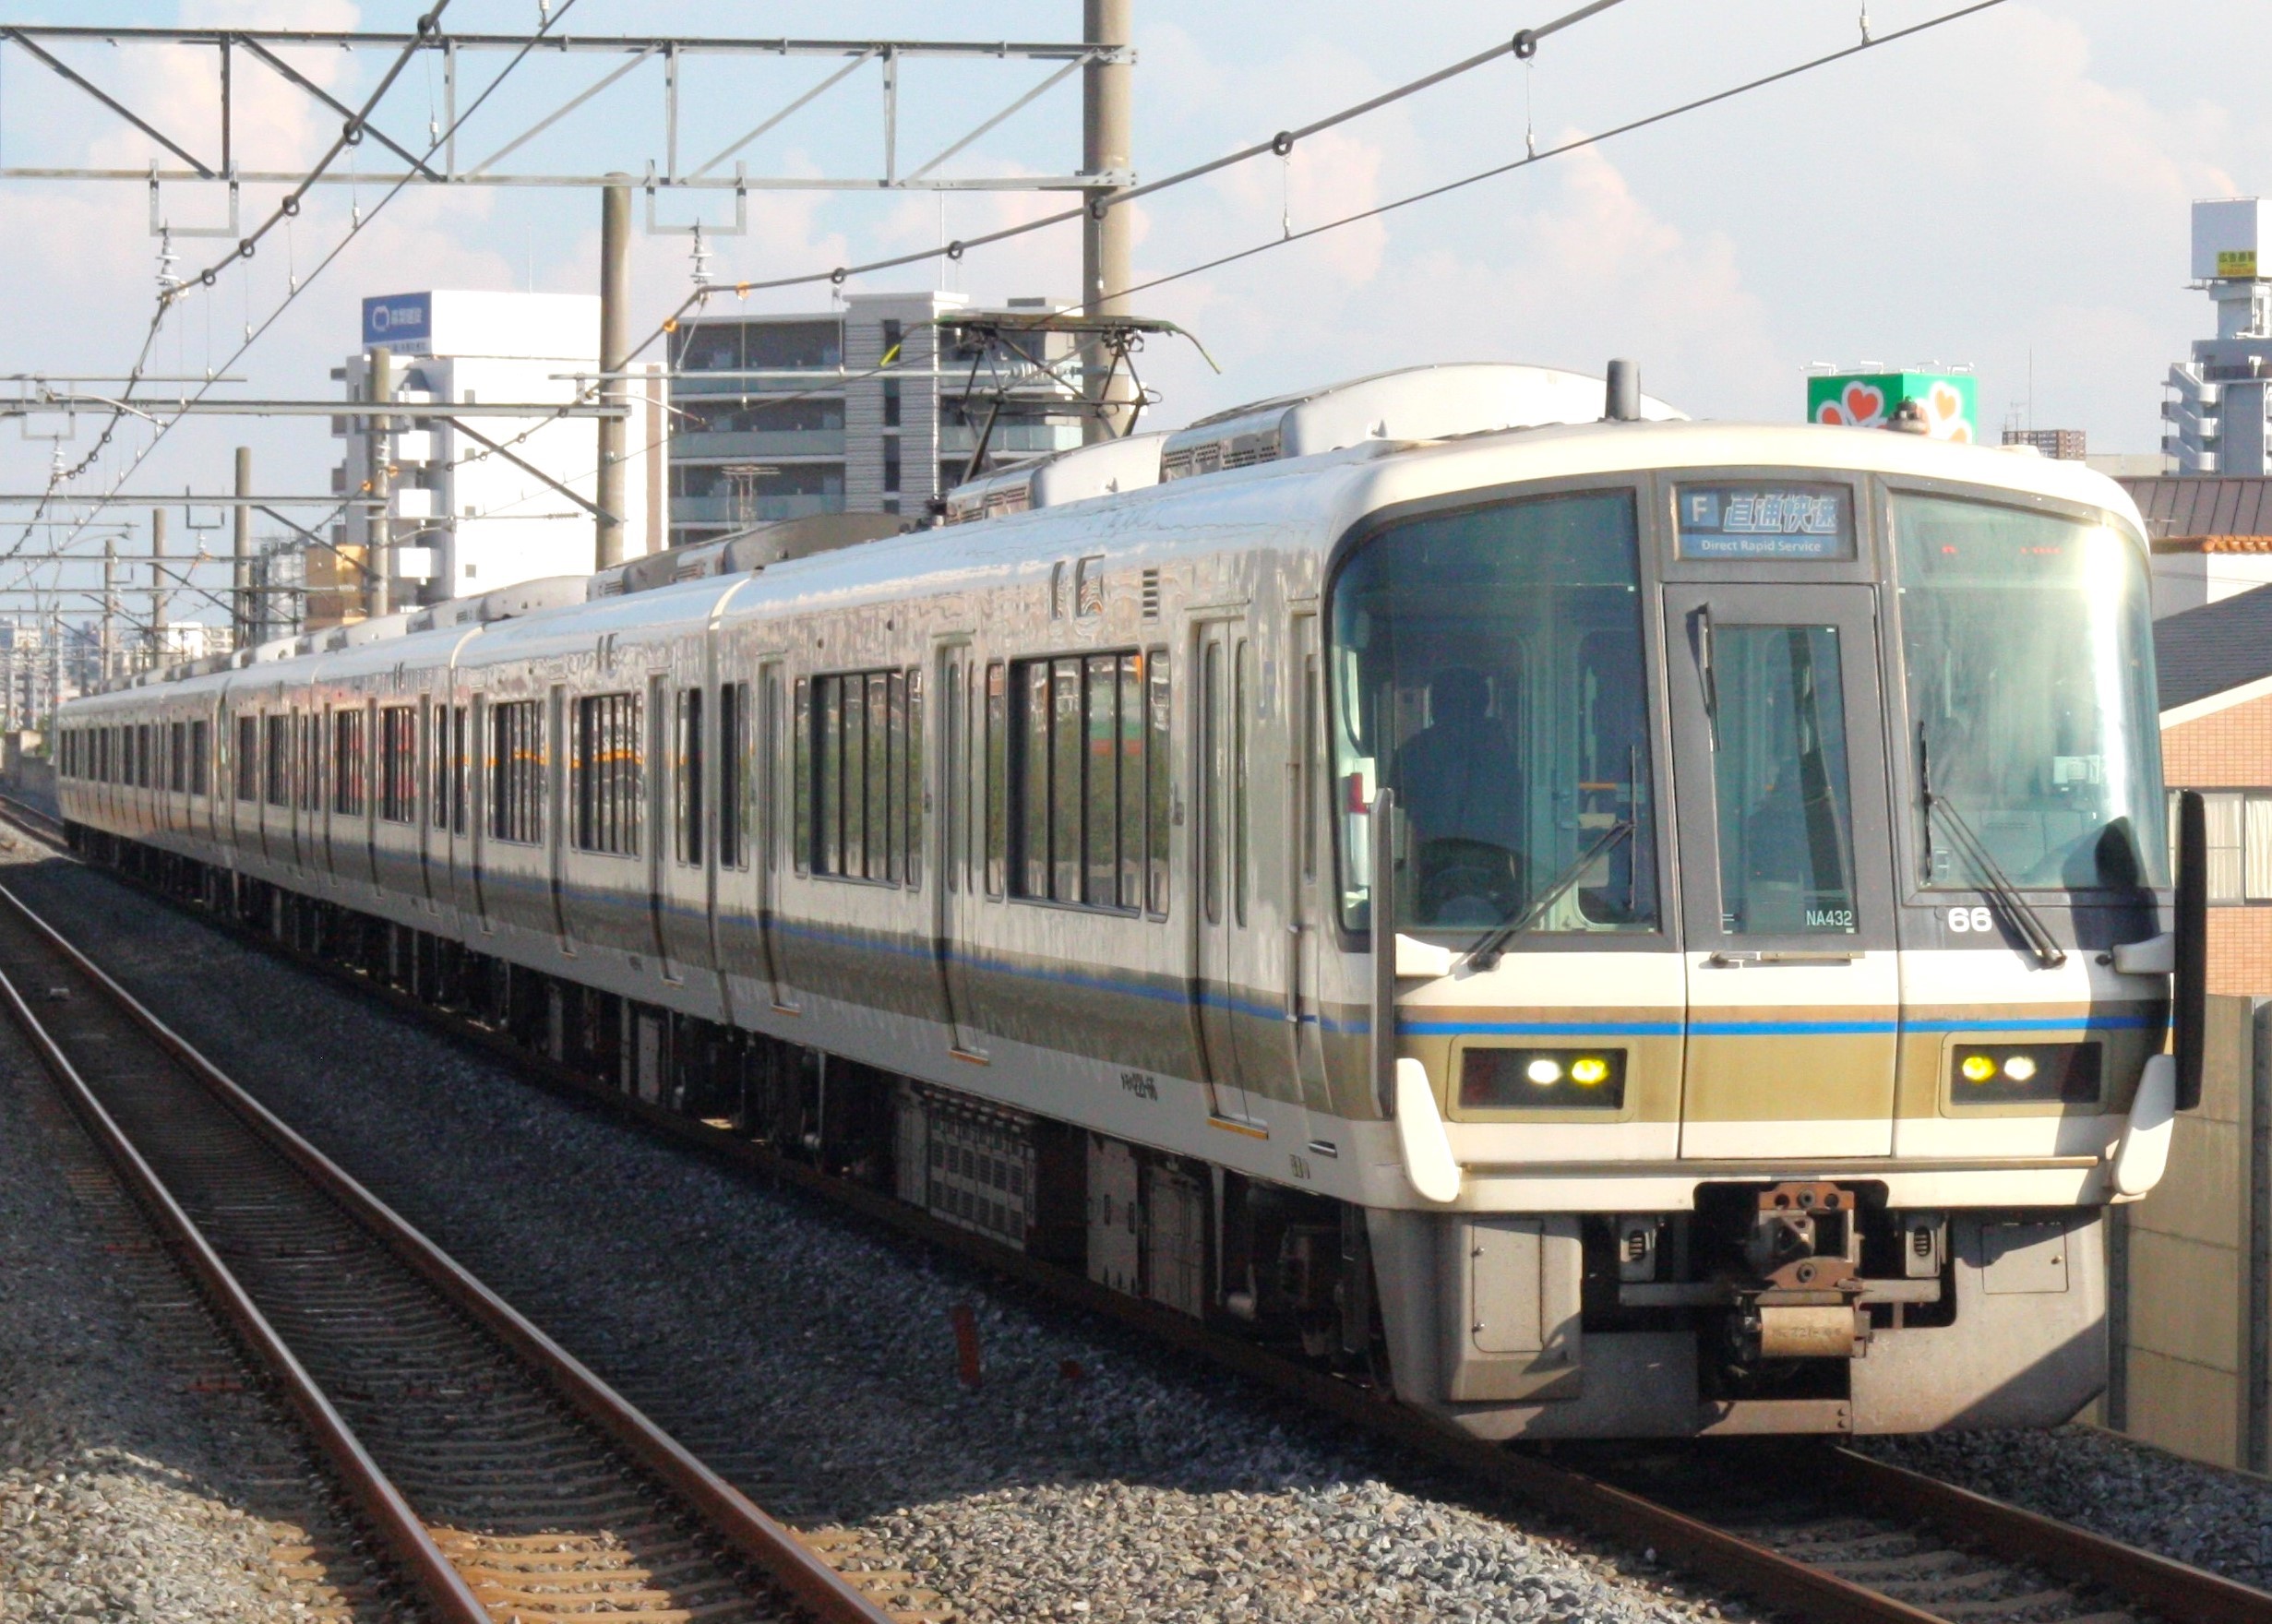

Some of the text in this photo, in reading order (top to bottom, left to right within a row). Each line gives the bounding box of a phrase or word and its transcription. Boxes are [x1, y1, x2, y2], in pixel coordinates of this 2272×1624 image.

[1692, 496, 1706, 522] F
[1723, 493, 1837, 533] 直通快速
[1702, 540, 1821, 553] Direct Rapid Service
[1806, 911, 1852, 926] NA432
[1948, 907, 1992, 932] 66
